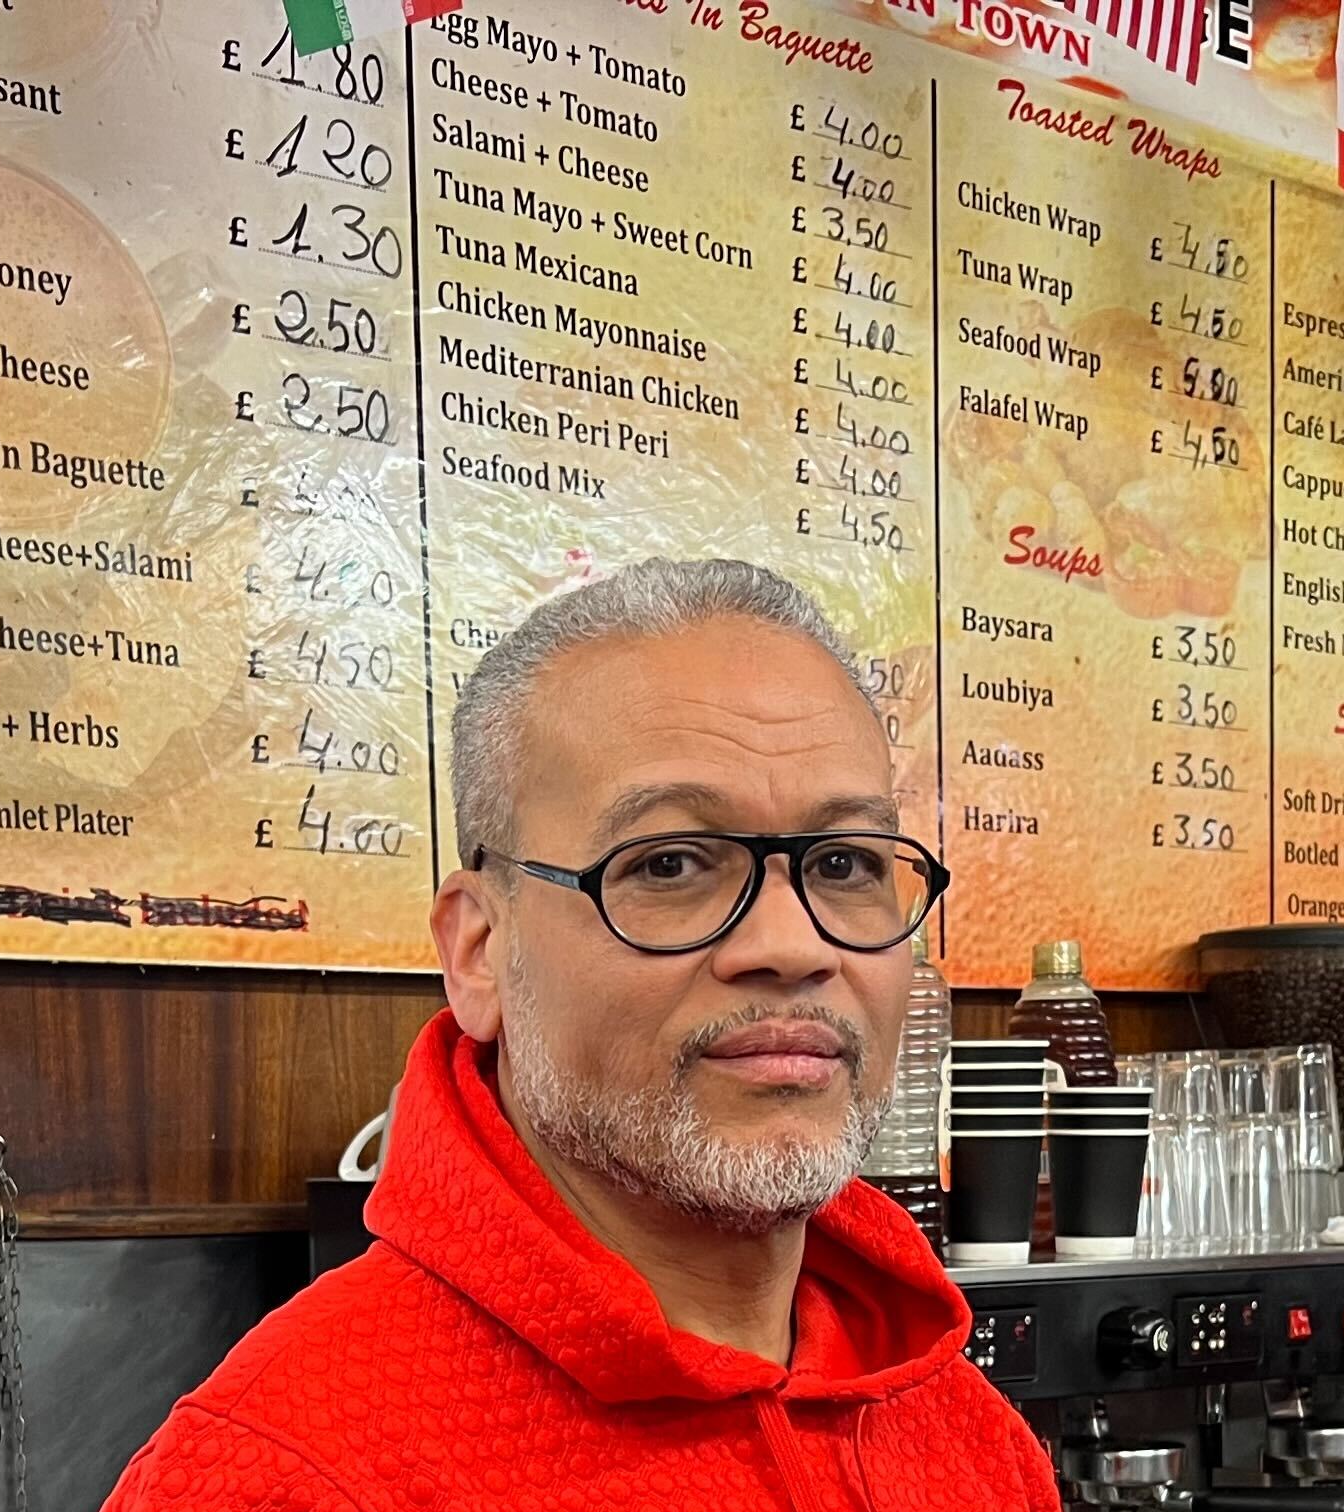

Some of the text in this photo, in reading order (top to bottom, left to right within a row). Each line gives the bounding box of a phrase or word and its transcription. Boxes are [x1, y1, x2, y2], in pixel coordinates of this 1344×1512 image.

[487, 16, 557, 64] Mayo
[589, 45, 686, 97] Tomato
[739, 0, 874, 74] Baguette
[957, 0, 1091, 66] TOWN
[431, 57, 658, 142] Cheese Tomato
[432, 113, 649, 192] Salami Cheese
[998, 78, 1222, 182] Toasted Wraps
[433, 168, 753, 270] Tuna Mayo Sweet Corn
[958, 181, 1101, 248] Chicken Wrap
[436, 224, 639, 296] Tuna Mexicana
[957, 248, 1073, 305] Tuna Wrap
[437, 280, 707, 362] Chicken Mayonnaise
[958, 318, 1101, 378] Seafood Wrap
[439, 335, 740, 420] Mediterranian Chicken
[441, 391, 670, 458] Chicken Peri Peri
[959, 385, 1088, 440] Falafel Wrap
[1283, 411, 1324, 440] Café
[30, 441, 166, 491] Baguette
[442, 446, 550, 491] Seafood
[558, 465, 606, 499] Mix
[1004, 525, 1103, 583] Soups
[1283, 518, 1317, 546] Hot
[961, 606, 1054, 642] Baysara
[1283, 625, 1335, 656] Fresh
[961, 673, 1054, 712] Loubiya
[29, 711, 120, 749] Herbs
[56, 803, 134, 837] Plater
[963, 806, 1039, 835] Harira
[1283, 788, 1315, 813] Soft
[1283, 841, 1339, 868] Botled
